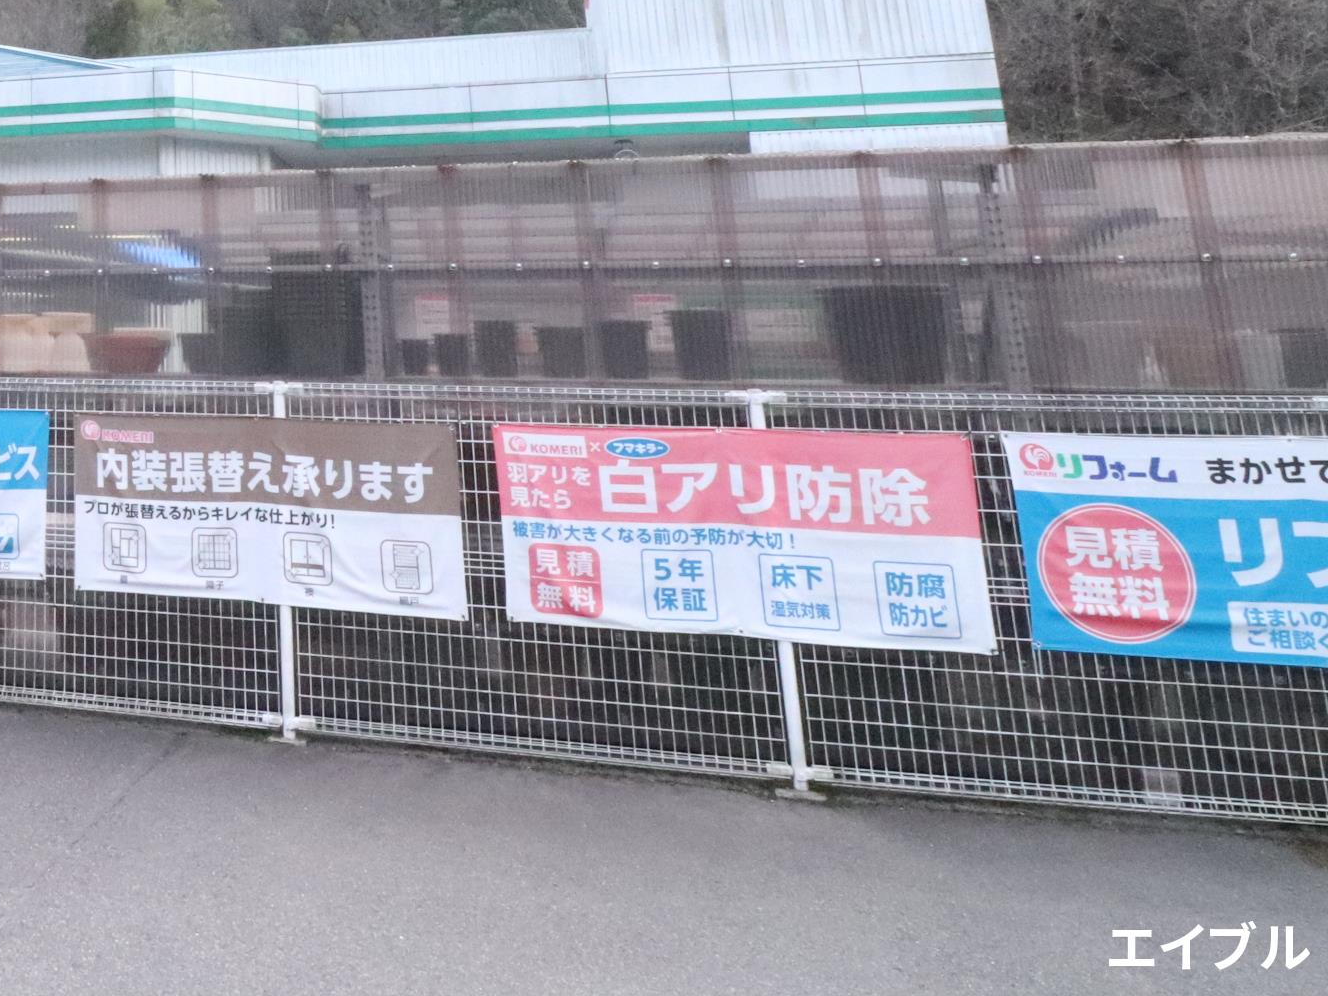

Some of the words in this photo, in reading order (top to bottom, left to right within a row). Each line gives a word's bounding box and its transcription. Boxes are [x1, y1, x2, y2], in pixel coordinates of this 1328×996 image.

[530, 443, 583, 455] KOMERI
[613, 441, 665, 455] フマキラー
[96, 447, 433, 504] 内装張替え承ります
[507, 461, 591, 487] 羽アリを
[510, 486, 572, 510] 見たら
[598, 458, 931, 528] 白アリ防除
[1065, 525, 1163, 572] 見積
[535, 548, 594, 578] 見積
[654, 557, 704, 582] 5年
[771, 564, 823, 591] 床下
[884, 571, 946, 600] 防腐
[536, 582, 597, 613] 無料
[653, 586, 708, 613] 保証
[1068, 571, 1170, 621] 無料
[888, 602, 949, 629] 防カビ
[1243, 607, 1328, 628] 住まいの
